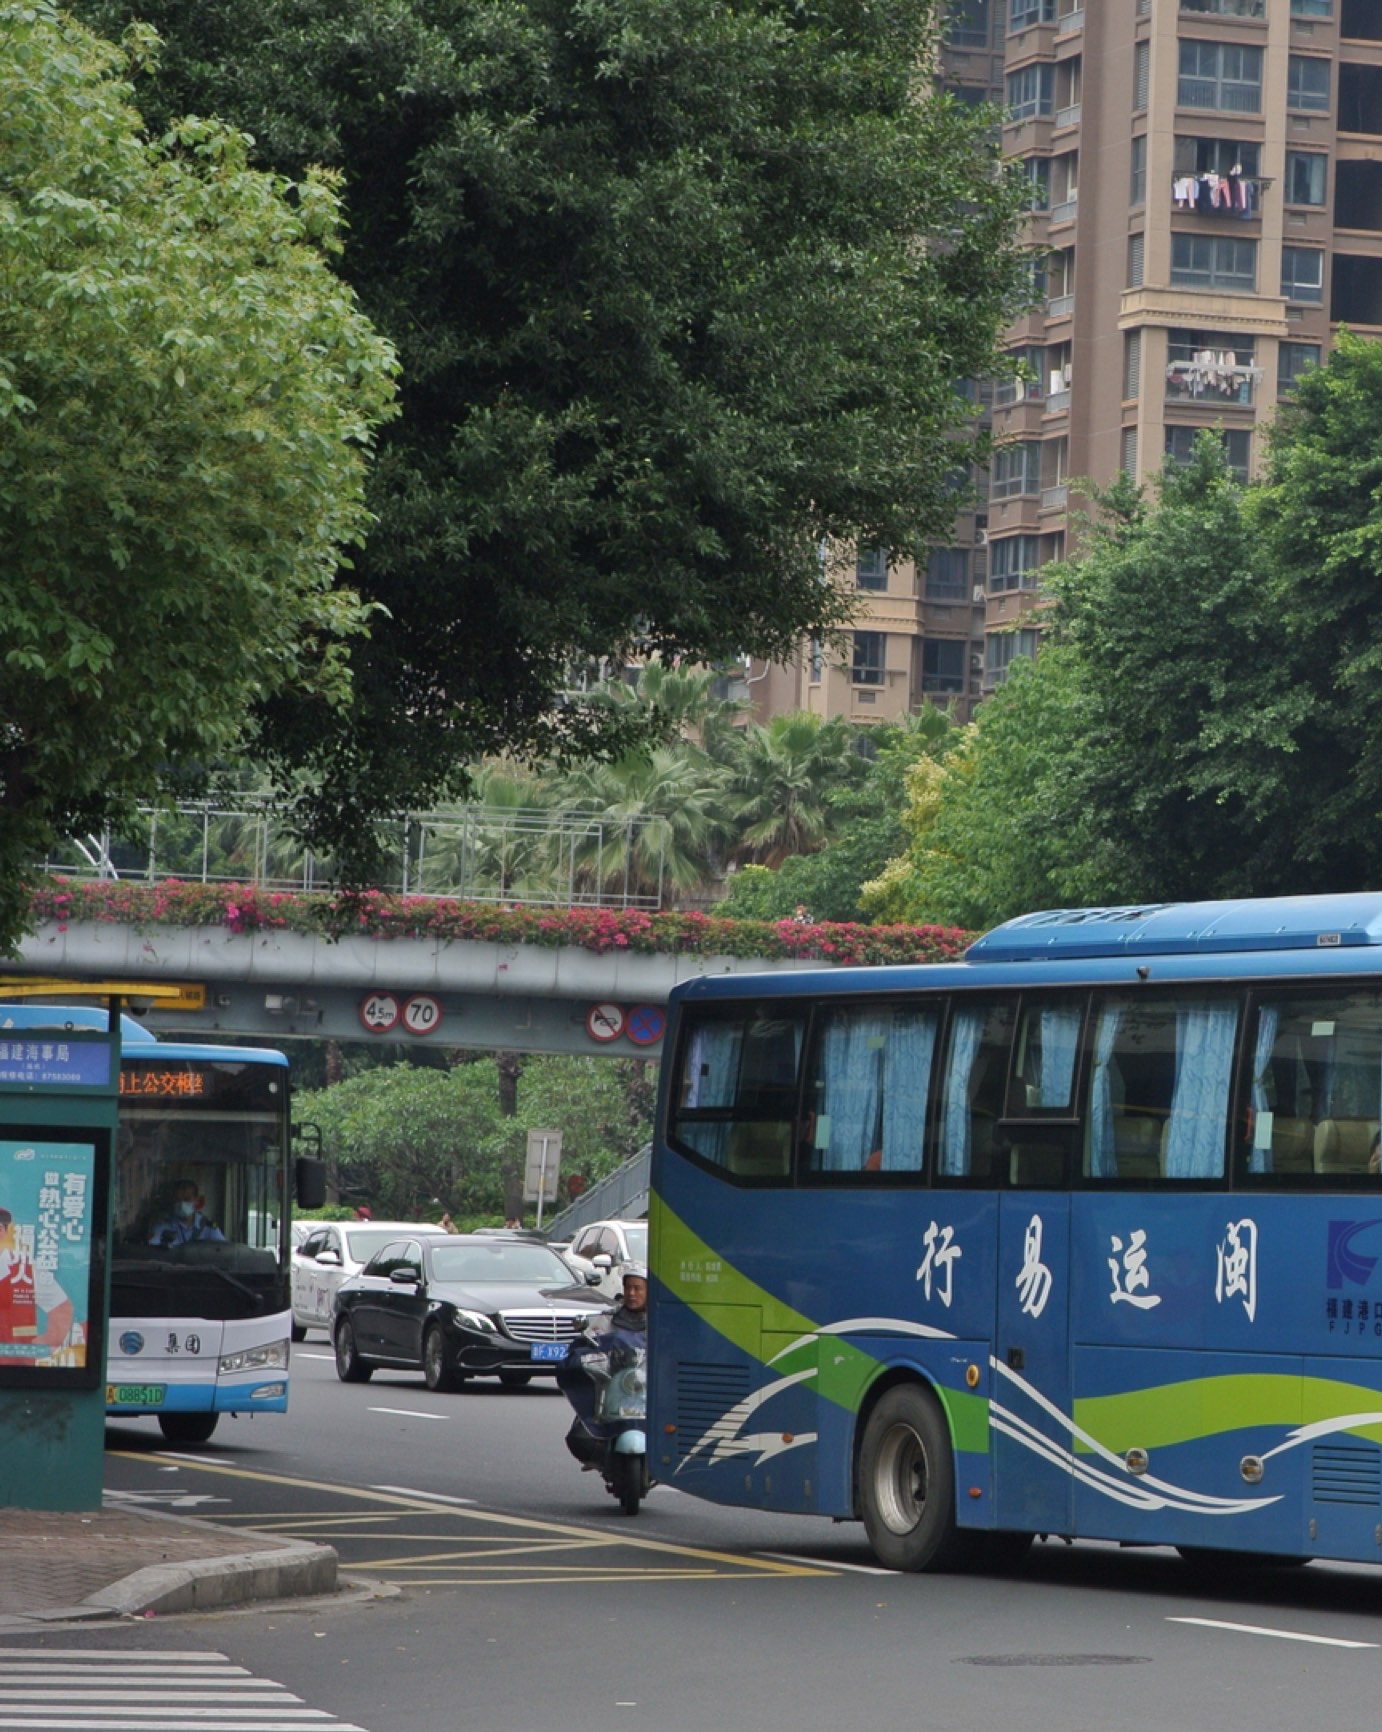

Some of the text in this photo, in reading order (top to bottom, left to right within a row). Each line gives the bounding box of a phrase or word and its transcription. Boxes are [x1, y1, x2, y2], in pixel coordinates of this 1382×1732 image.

[411, 1003, 433, 1023] 70
[62, 1172, 87, 1241] 有爱心
[10, 1223, 36, 1285] 福州人
[164, 1332, 201, 1355] 集团
